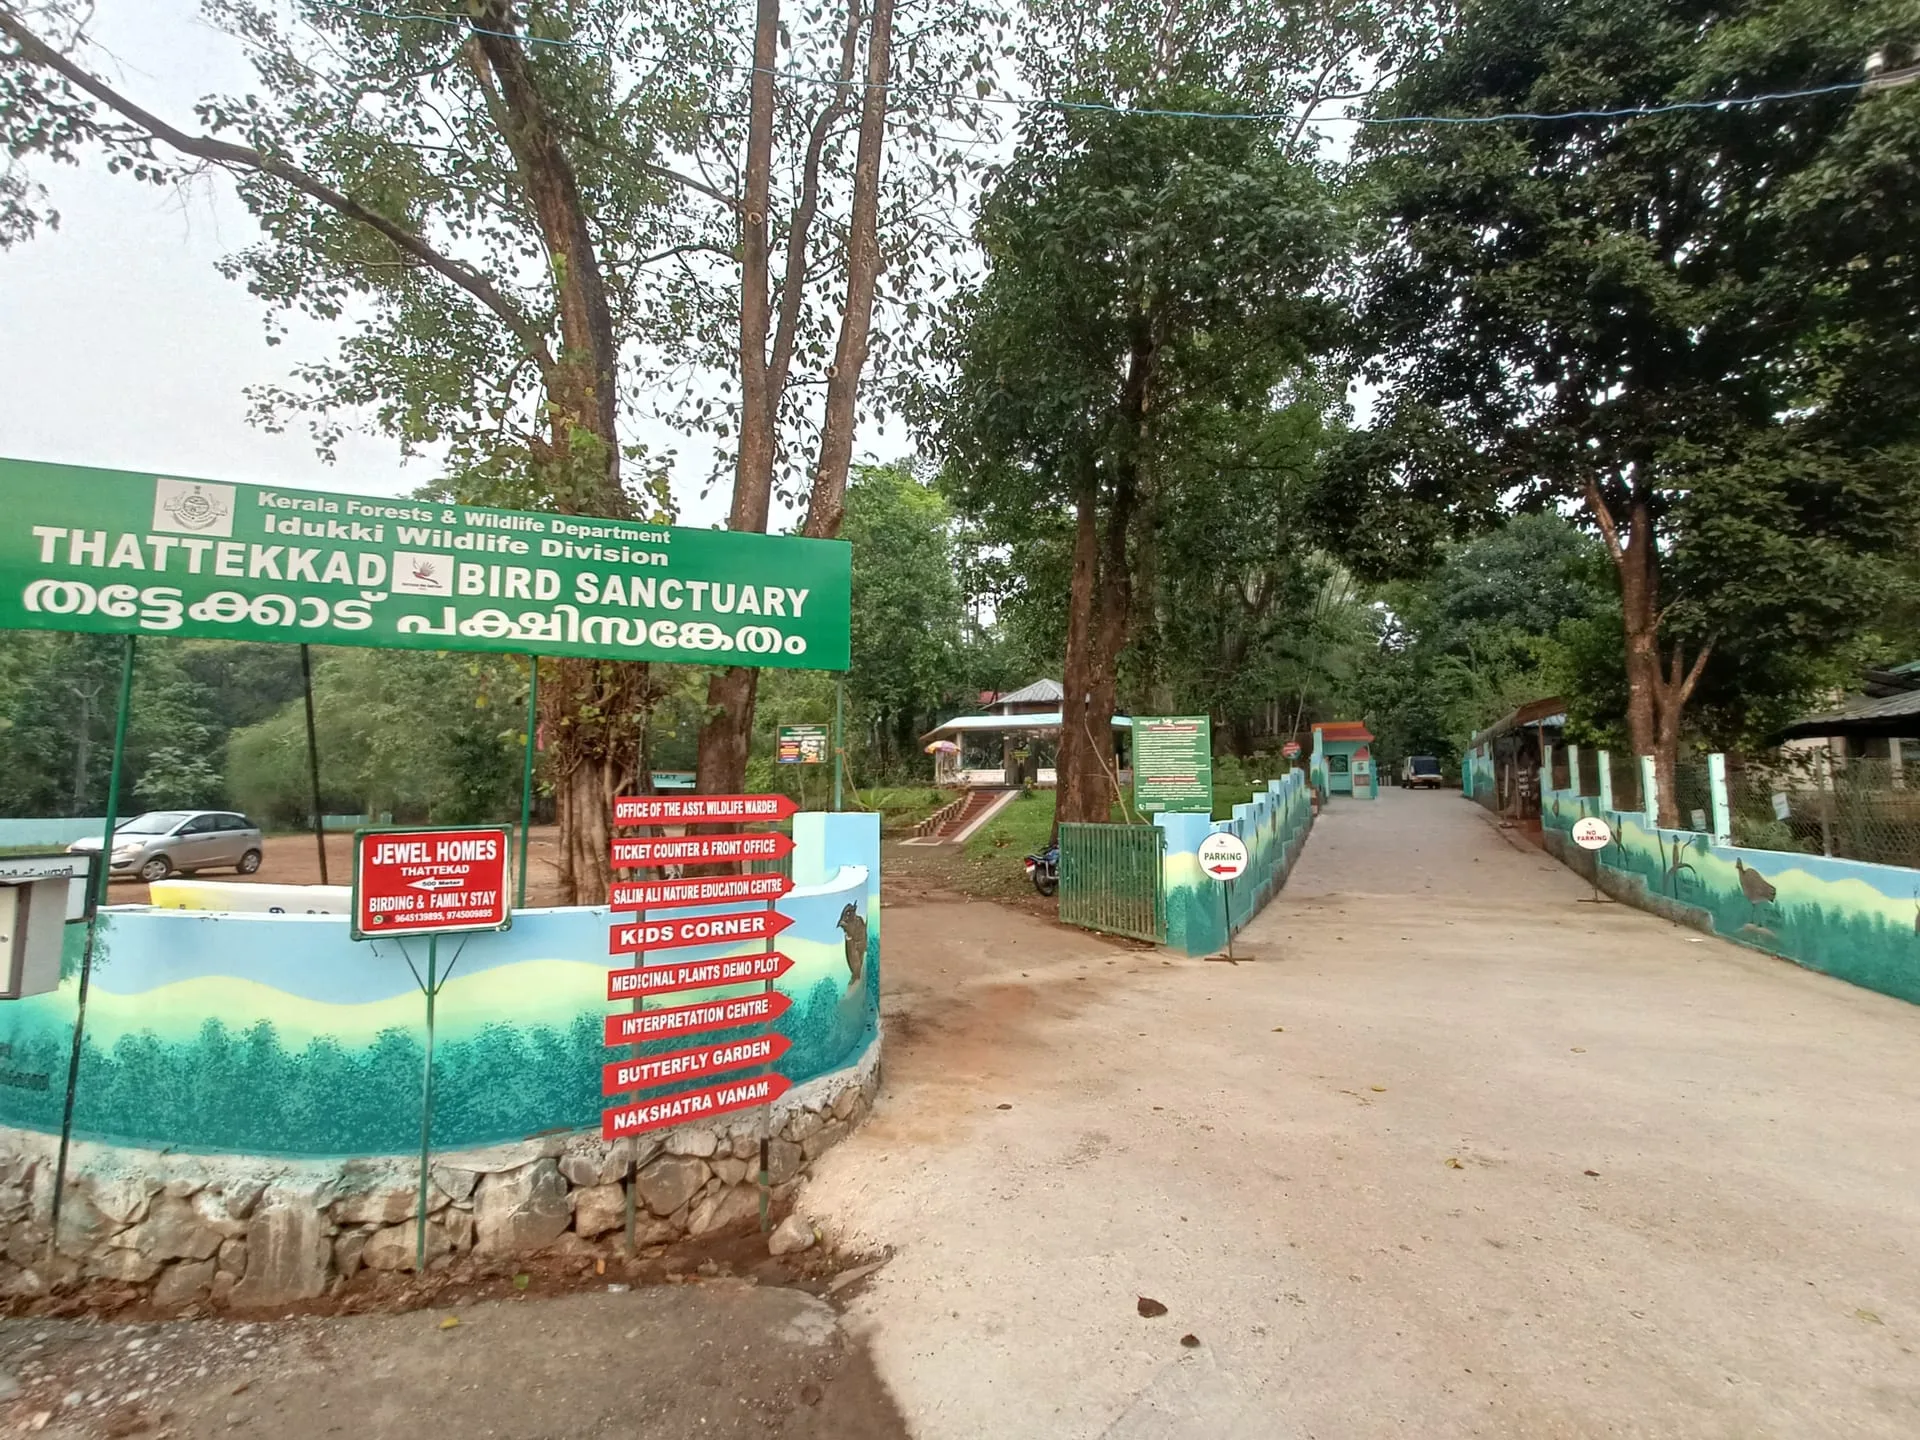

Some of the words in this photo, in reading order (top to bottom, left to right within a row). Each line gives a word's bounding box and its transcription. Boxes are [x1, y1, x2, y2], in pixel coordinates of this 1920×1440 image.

[258, 491, 339, 514] Kerala
[346, 501, 433, 522] Forests
[441, 509, 457, 525] &
[464, 511, 545, 532] Wildlife
[552, 519, 671, 545] Department
[264, 514, 384, 543] Idukki
[397, 526, 530, 555] Wildlife
[541, 538, 669, 567] Division
[32, 526, 388, 587] THATTEKKAD
[458, 562, 561, 601] BIRD
[574, 571, 809, 618] SANCTUARY
[23, 578, 388, 630] തട്ടേക്കാട്
[397, 604, 807, 655] പക്ഷിസങ്കേതം
[616, 803, 648, 818] OFFICE
[650, 803, 661, 817] OF
[664, 802, 680, 816] THE
[682, 802, 705, 816] ASST.
[706, 801, 743, 815] WILDLIFE
[745, 800, 777, 814] WARDEN
[372, 842, 431, 865] JEWEL
[436, 840, 497, 862] HOMES
[614, 844, 652, 860] TICKET
[654, 842, 700, 858] COUNTER
[702, 841, 709, 856] &
[711, 840, 741, 855] FRONT
[743, 839, 775, 854] OFFICE
[1204, 852, 1242, 861] PARKING
[401, 865, 470, 876] THATTEKAD
[369, 896, 414, 913] BIRDING
[416, 895, 424, 909] &
[430, 893, 470, 908] FAMILY
[470, 891, 496, 906] STAY
[645, 888, 661, 902] ALI
[663, 884, 699, 901] NATURE
[701, 881, 749, 898] EDUCATION
[750, 878, 782, 895] CENTRE
[620, 925, 674, 946] KIDS
[681, 917, 765, 939] CORNER
[612, 972, 675, 993] MEDICINAL
[678, 965, 720, 984] PLANTS
[723, 961, 750, 978] DEMO
[754, 957, 779, 973] PLOT
[622, 1006, 724, 1036] INTERPRETATION
[726, 999, 768, 1019] CENTRE
[617, 1052, 709, 1085] BUTTERFLY
[712, 1040, 770, 1065] GARDEN
[613, 1094, 712, 1130] NAKSHATRA
[716, 1081, 768, 1102] VANAM
